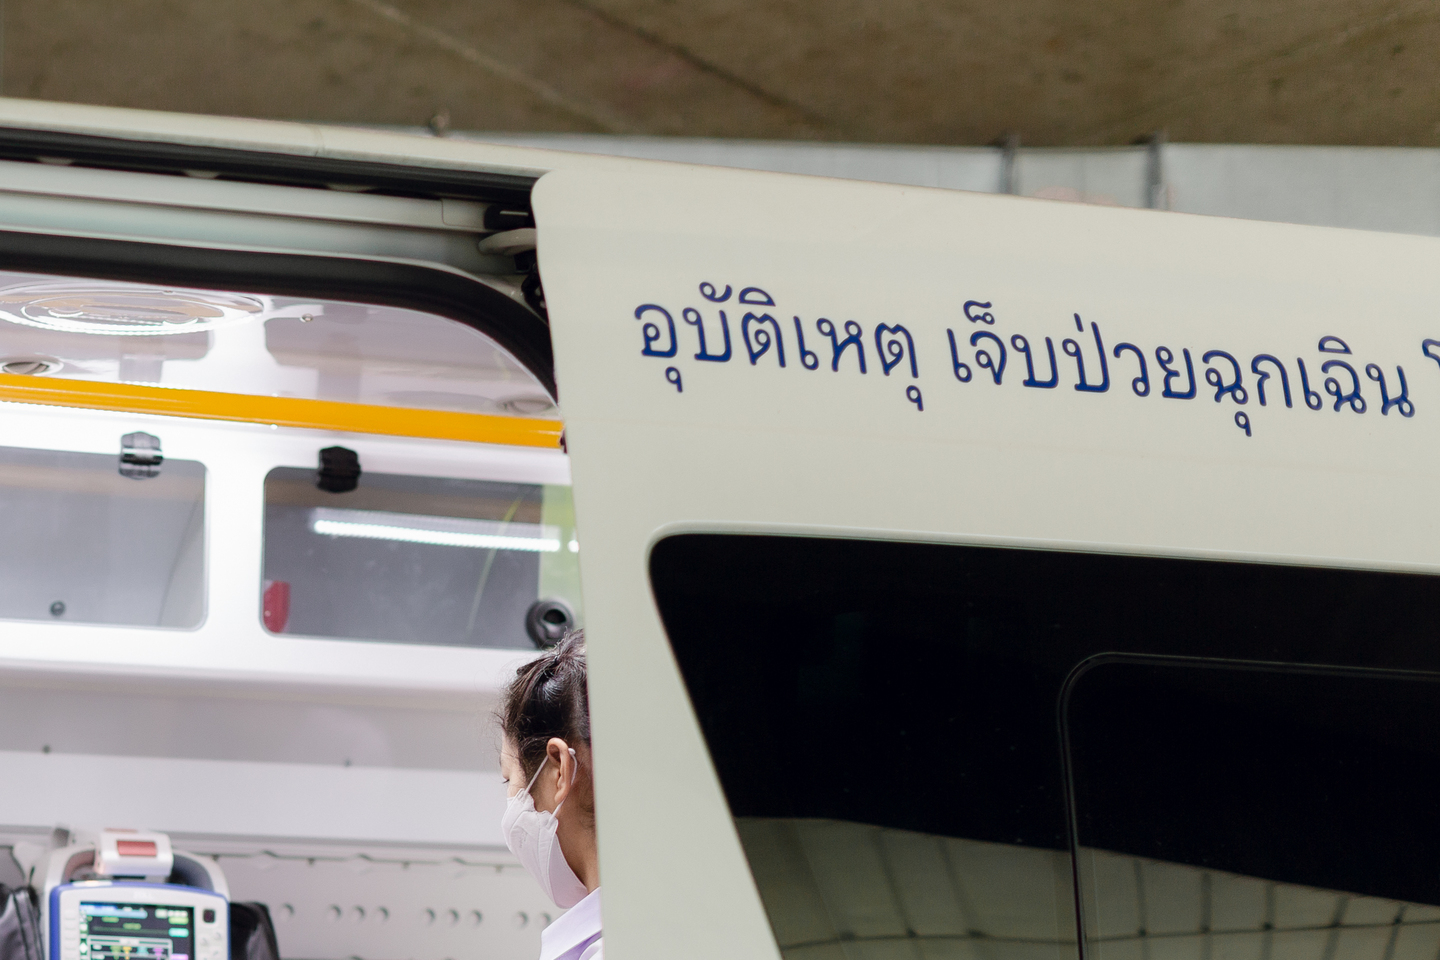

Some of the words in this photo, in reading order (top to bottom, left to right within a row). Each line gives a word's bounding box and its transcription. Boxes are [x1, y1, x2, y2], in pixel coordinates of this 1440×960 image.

[634, 281, 925, 411] อุบัติเหตุ
[946, 300, 1416, 437] เจ็บป่วยฉุกเฉิน
